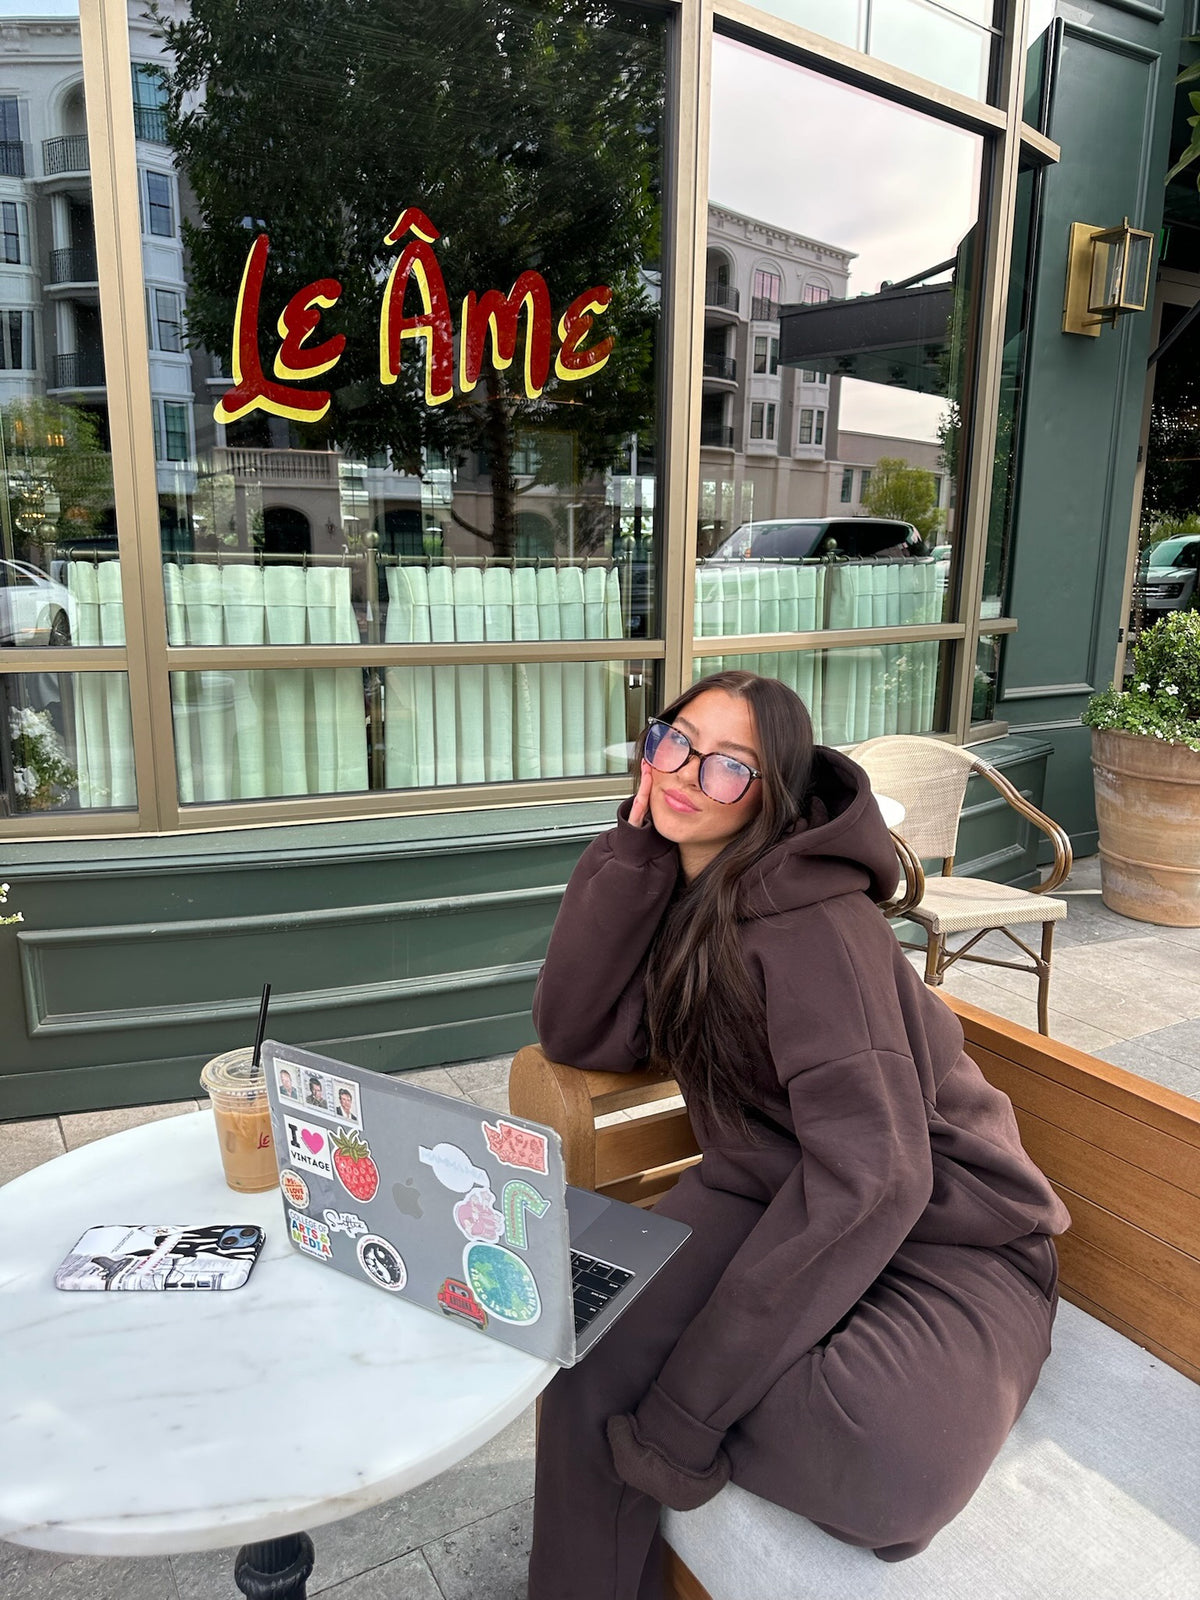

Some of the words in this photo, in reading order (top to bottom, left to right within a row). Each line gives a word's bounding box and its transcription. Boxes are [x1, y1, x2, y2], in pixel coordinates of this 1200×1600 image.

[288, 1123, 301, 1148] I
[290, 1150, 331, 1171] VINTAGE
[289, 1187, 304, 1195] LOVE
[290, 1210, 317, 1229] COLLEGE
[292, 1219, 318, 1240] ARTS
[292, 1229, 331, 1256] MEDIA
